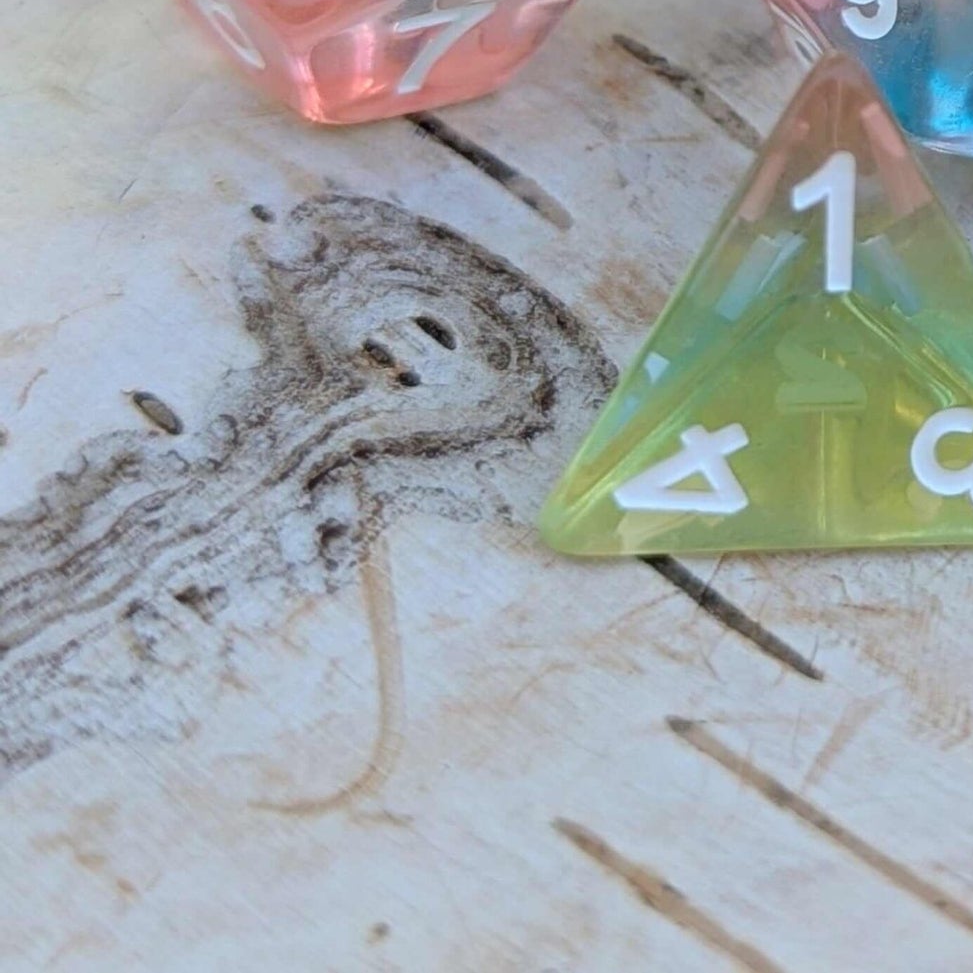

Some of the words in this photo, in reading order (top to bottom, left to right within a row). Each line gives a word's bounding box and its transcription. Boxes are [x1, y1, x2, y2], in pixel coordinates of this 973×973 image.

[394, 2, 497, 95] 7
[791, 150, 856, 293] 1
[614, 423, 749, 514] 4
